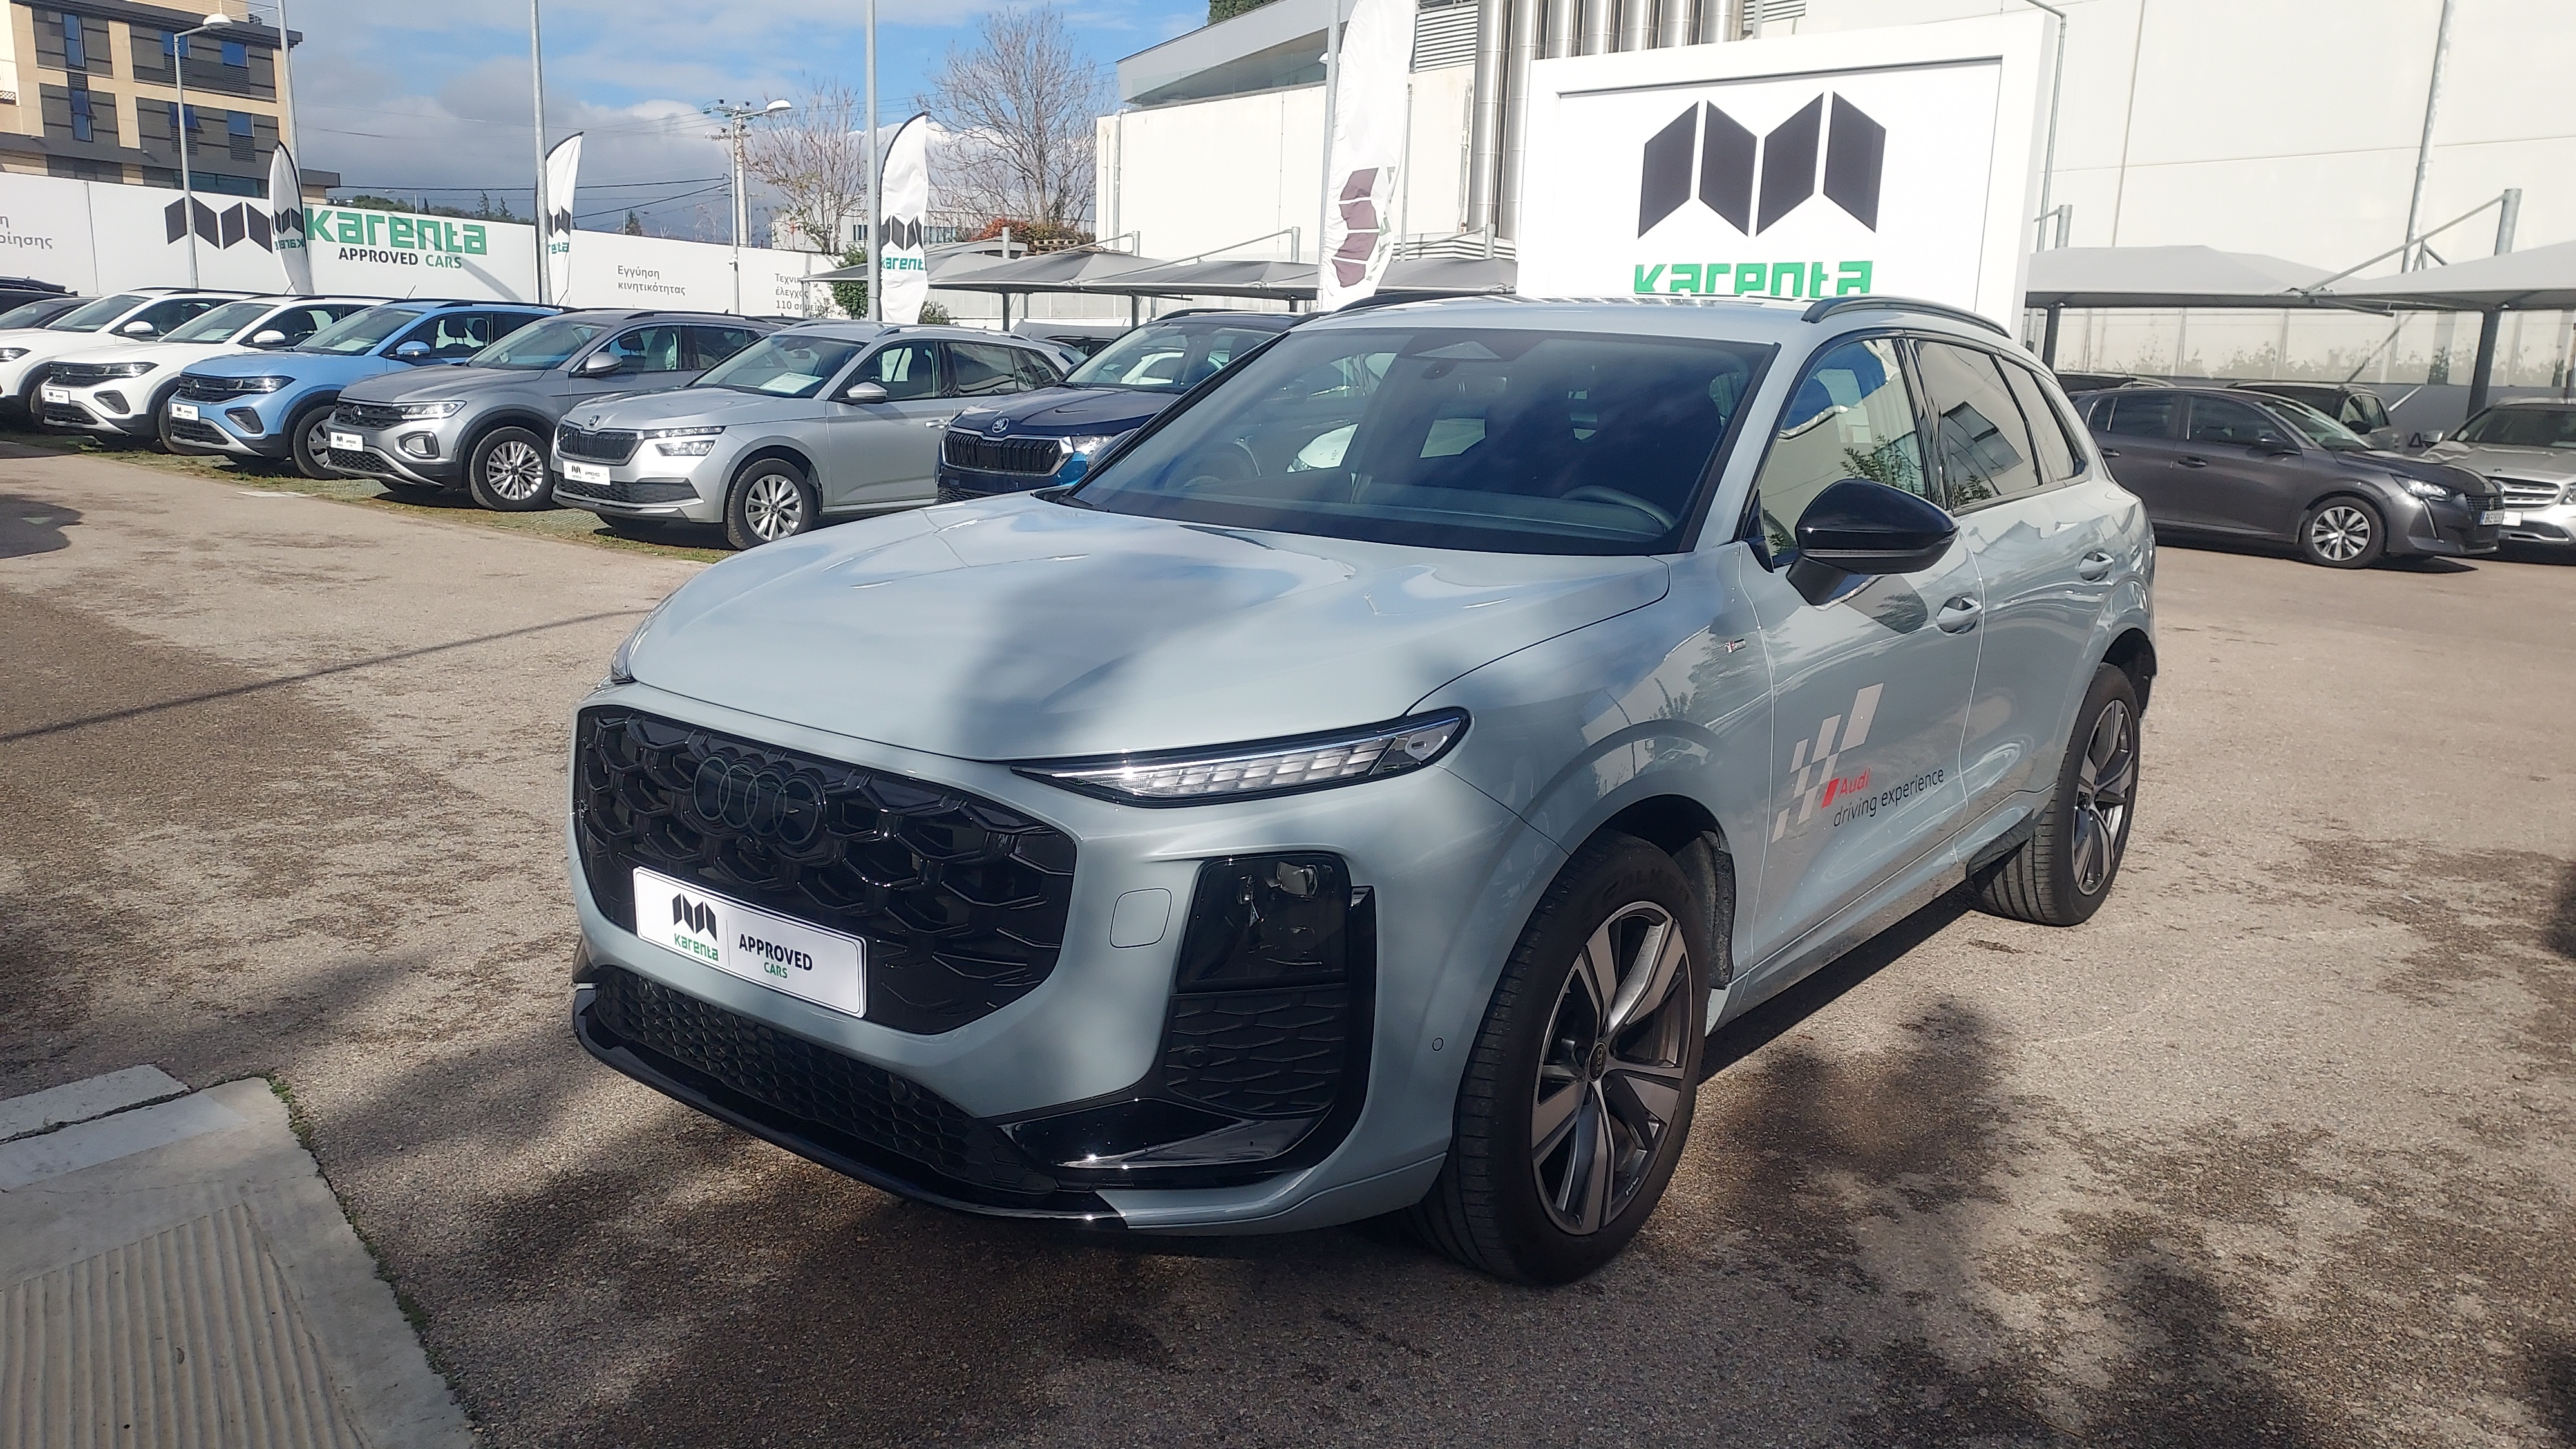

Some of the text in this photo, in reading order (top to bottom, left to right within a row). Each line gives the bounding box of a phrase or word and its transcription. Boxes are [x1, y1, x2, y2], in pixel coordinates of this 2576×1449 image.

[339, 247, 462, 269] APPROVED CARS
[618, 265, 660, 280] Εγγύηση
[775, 273, 810, 286] Τεχνι
[618, 281, 685, 296] κινητικότητας
[776, 300, 792, 310] 110
[1838, 768, 1871, 798] Audi
[1833, 769, 1945, 827] driving experience
[739, 933, 813, 971] APPROVED
[764, 961, 788, 979] CARS
